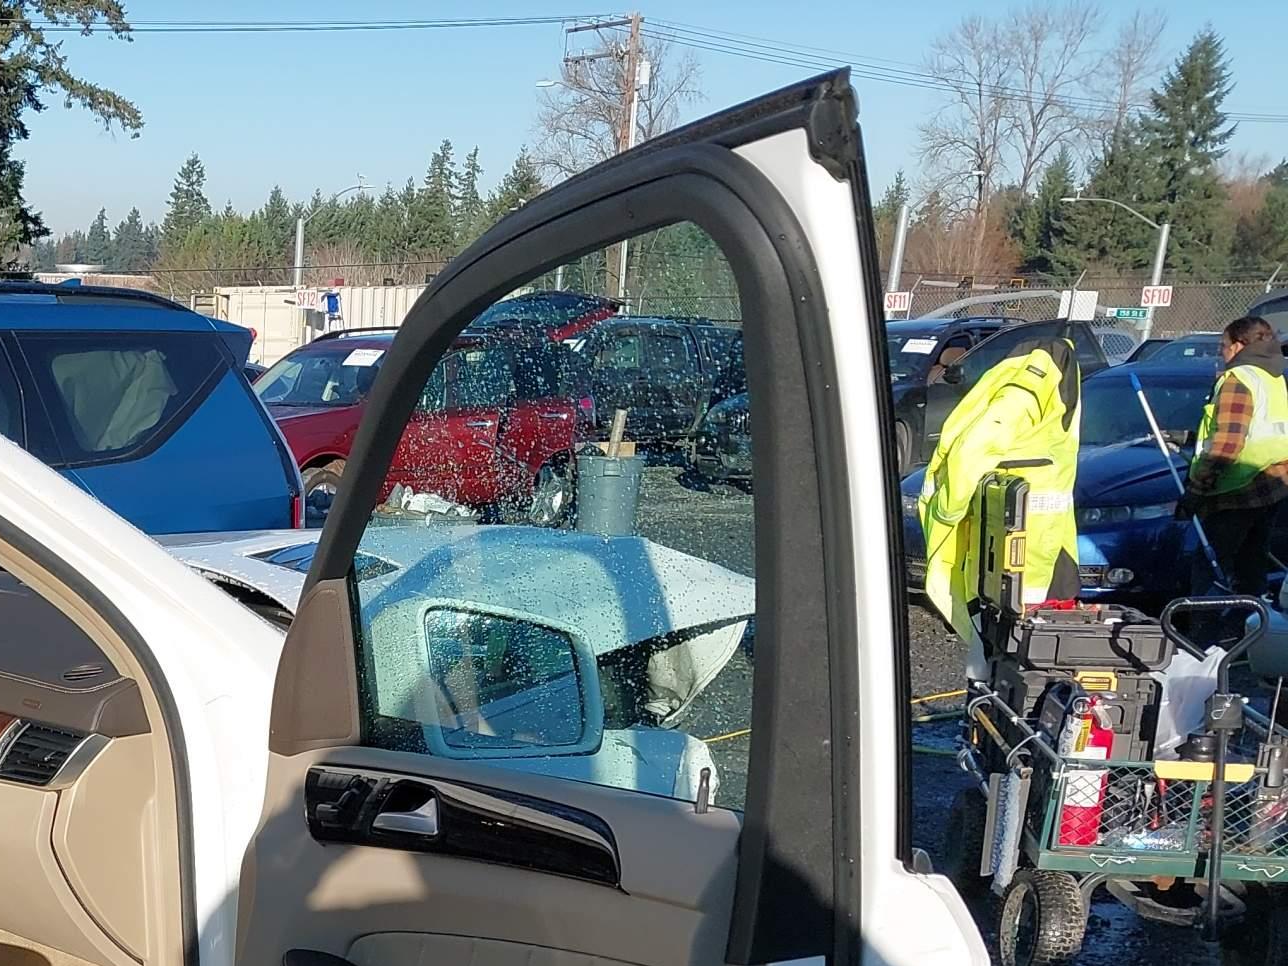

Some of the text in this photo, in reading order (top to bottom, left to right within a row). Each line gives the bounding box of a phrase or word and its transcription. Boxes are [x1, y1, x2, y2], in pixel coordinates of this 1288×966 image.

[297, 292, 316, 306] SF12
[887, 295, 906, 308] SF11
[1144, 288, 1170, 304] SF10
